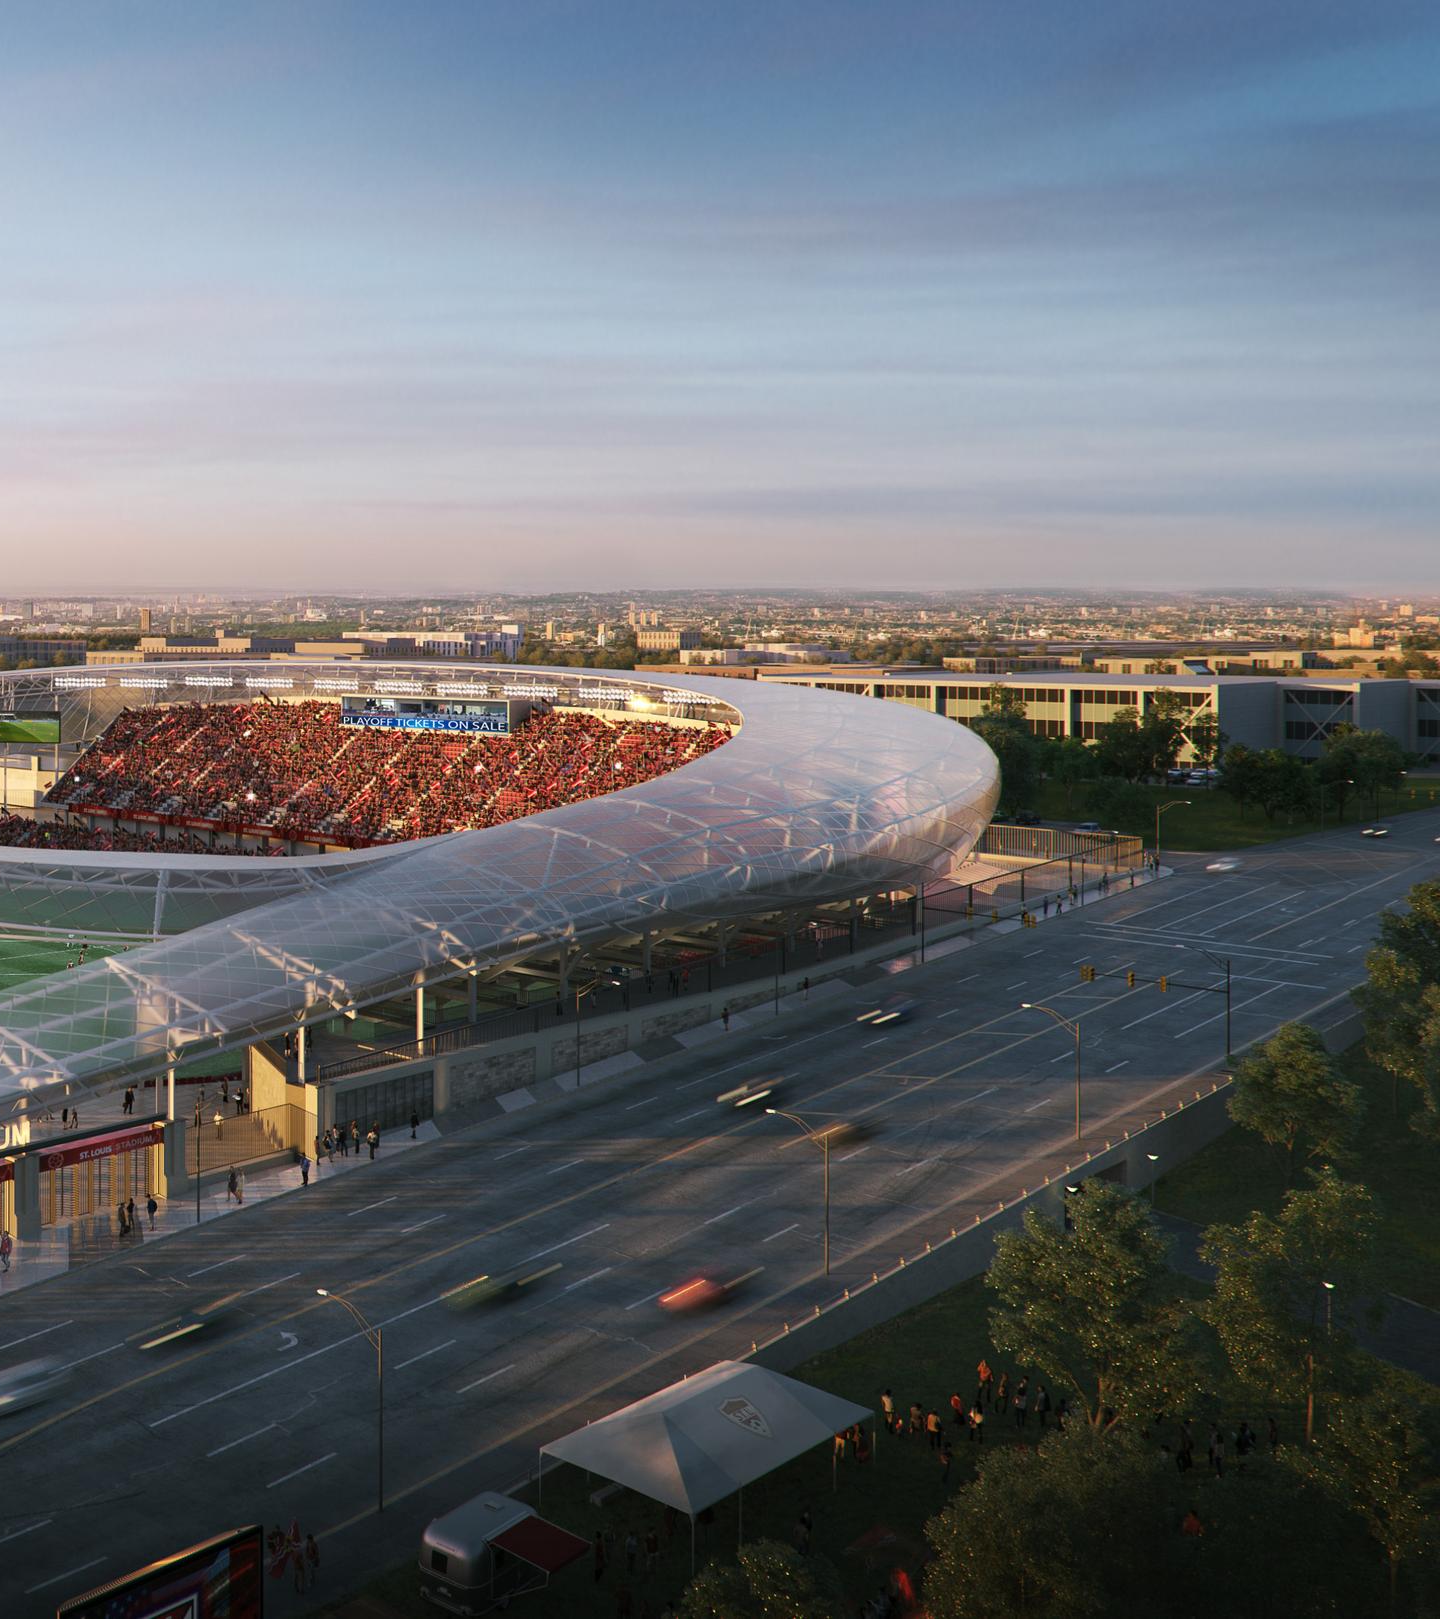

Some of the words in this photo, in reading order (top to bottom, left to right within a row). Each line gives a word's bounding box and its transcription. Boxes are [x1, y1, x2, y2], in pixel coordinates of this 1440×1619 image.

[343, 716, 393, 726] PLAYOFF
[396, 718, 445, 729] TICKETS
[448, 720, 468, 730] ON
[471, 722, 505, 732] SALE
[91, 1145, 113, 1157] LOUIS
[115, 1135, 154, 1151] STADIUM
